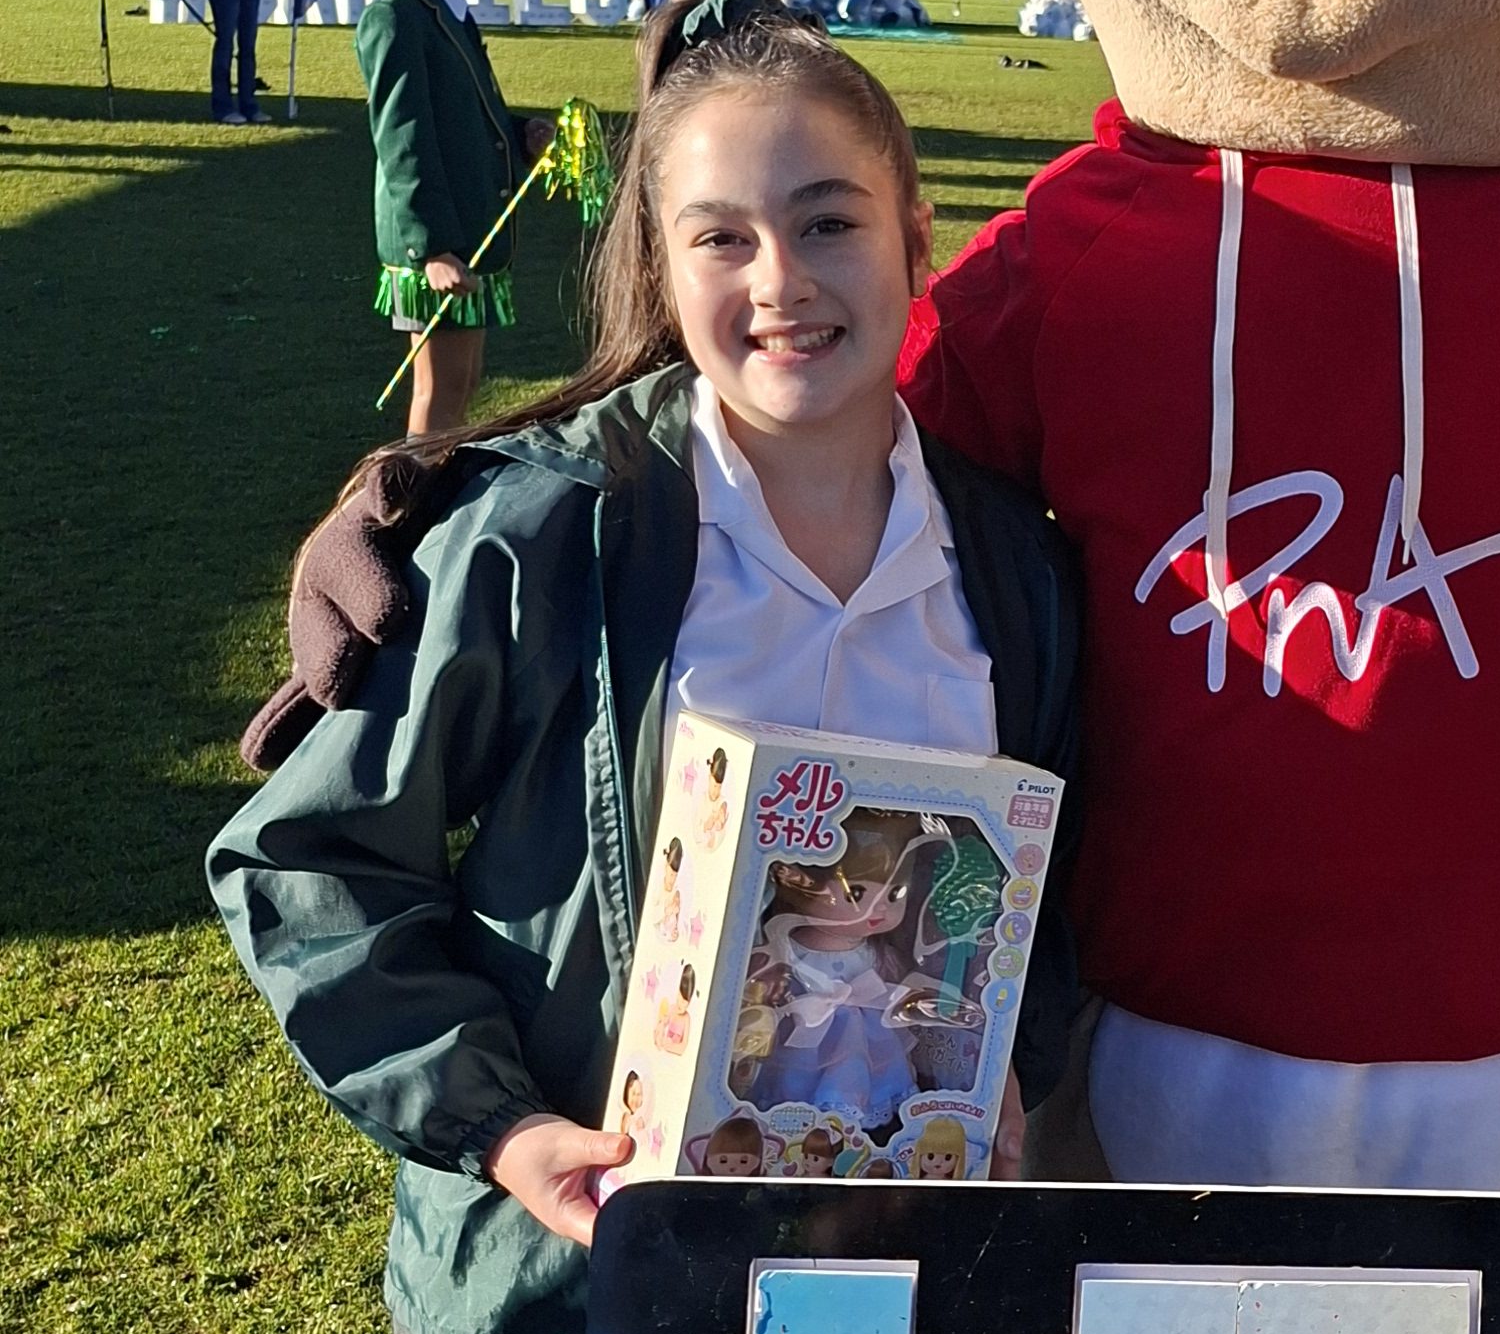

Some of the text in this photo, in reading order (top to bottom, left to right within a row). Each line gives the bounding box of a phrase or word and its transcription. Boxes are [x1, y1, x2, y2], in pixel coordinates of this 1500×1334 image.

[759, 762, 844, 813] メル
[1027, 784, 1056, 795] PILOT
[756, 811, 835, 849] ちゃん
